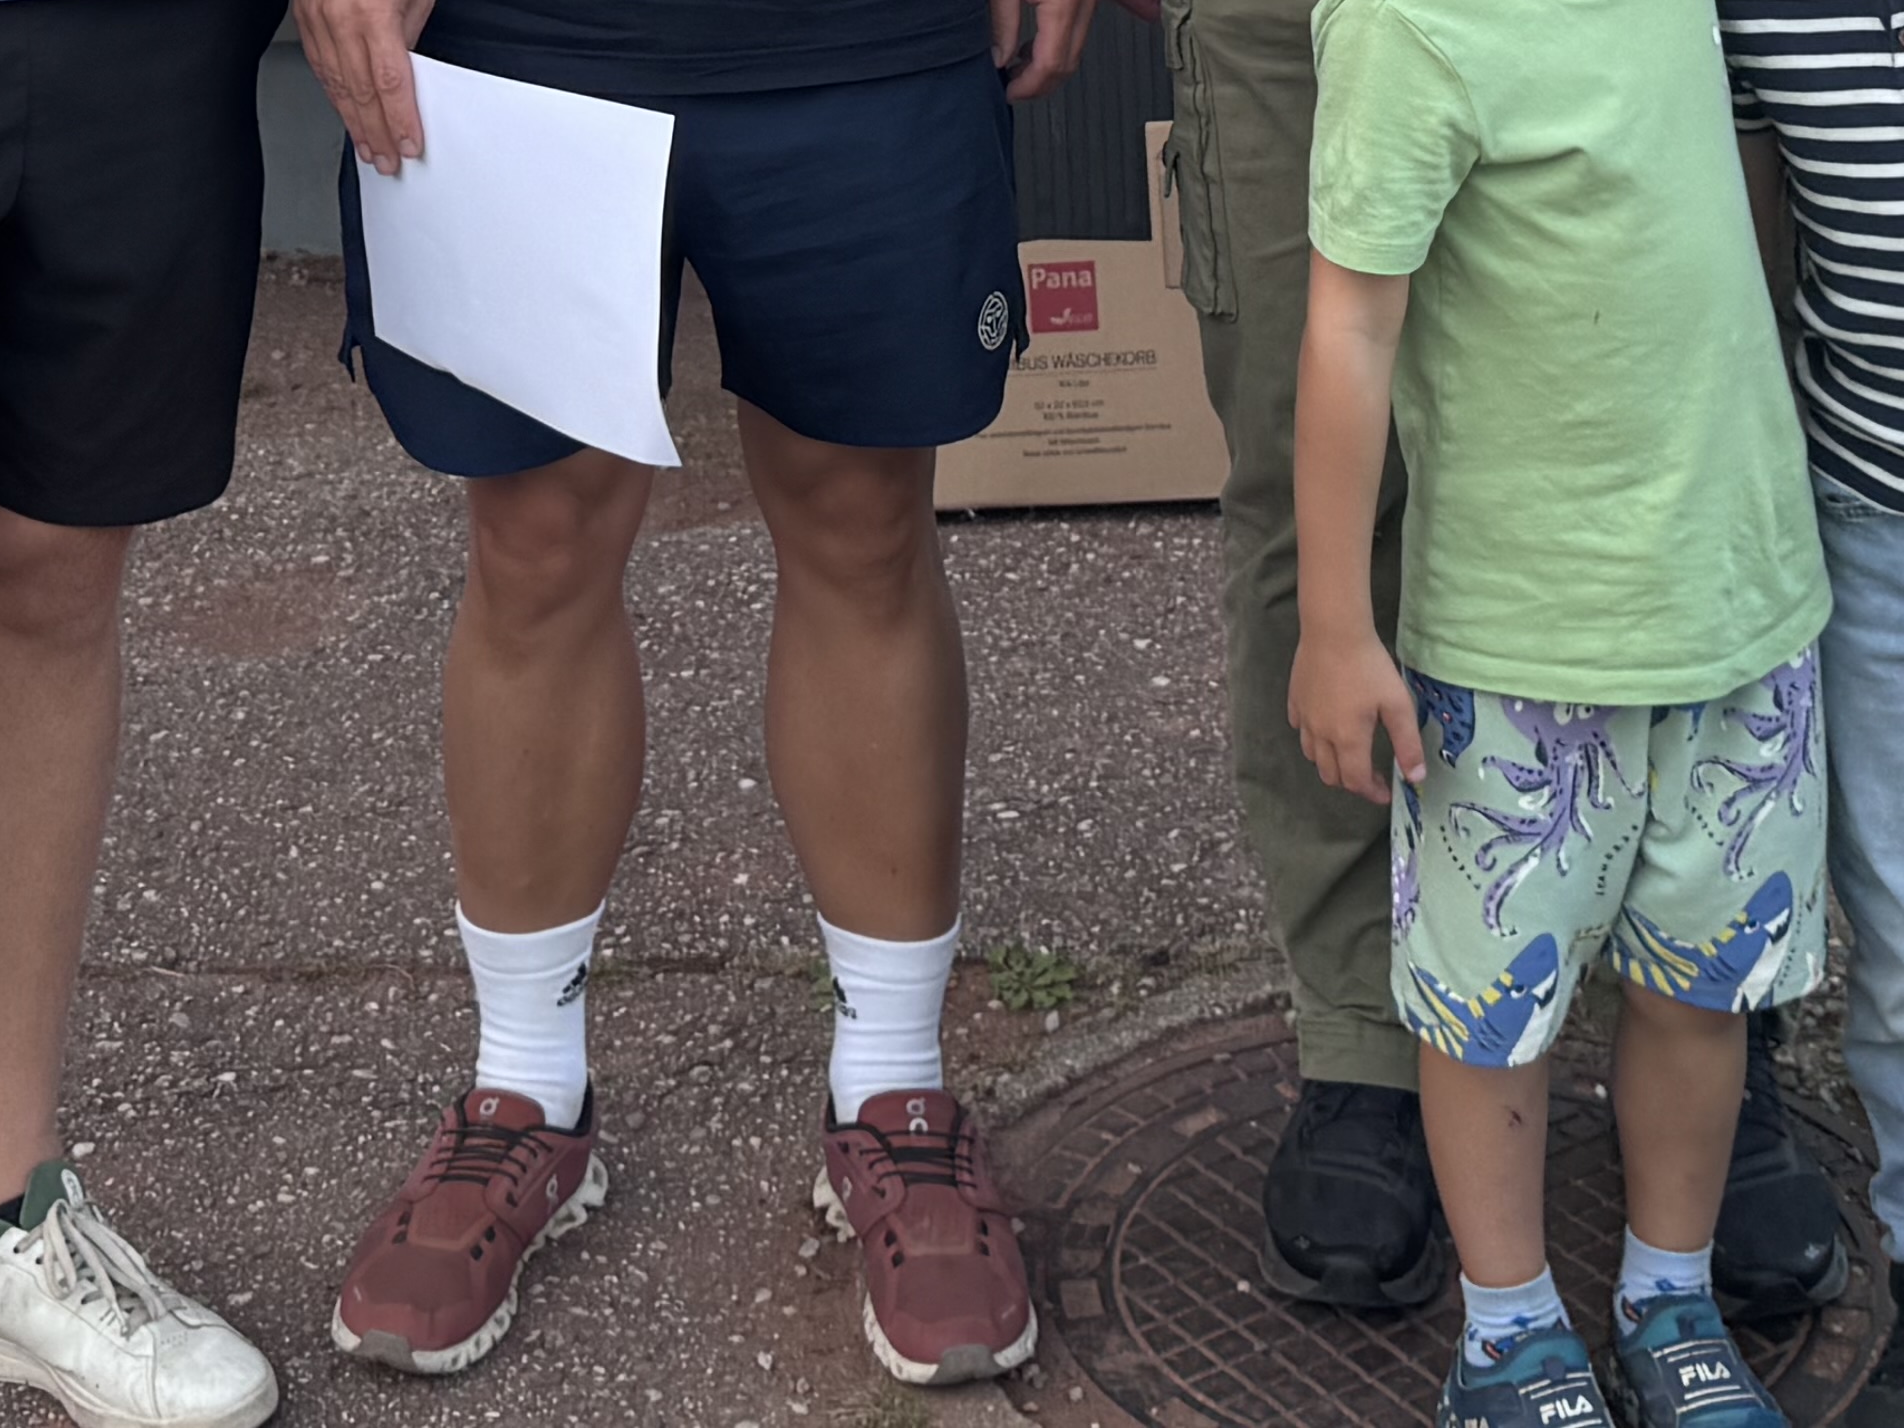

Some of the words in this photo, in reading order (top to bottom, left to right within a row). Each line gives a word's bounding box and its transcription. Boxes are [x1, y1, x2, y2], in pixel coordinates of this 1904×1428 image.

[1031, 267, 1093, 290] Pana
[1678, 1360, 1731, 1388] FILA
[1539, 1393, 1594, 1425] FILA
